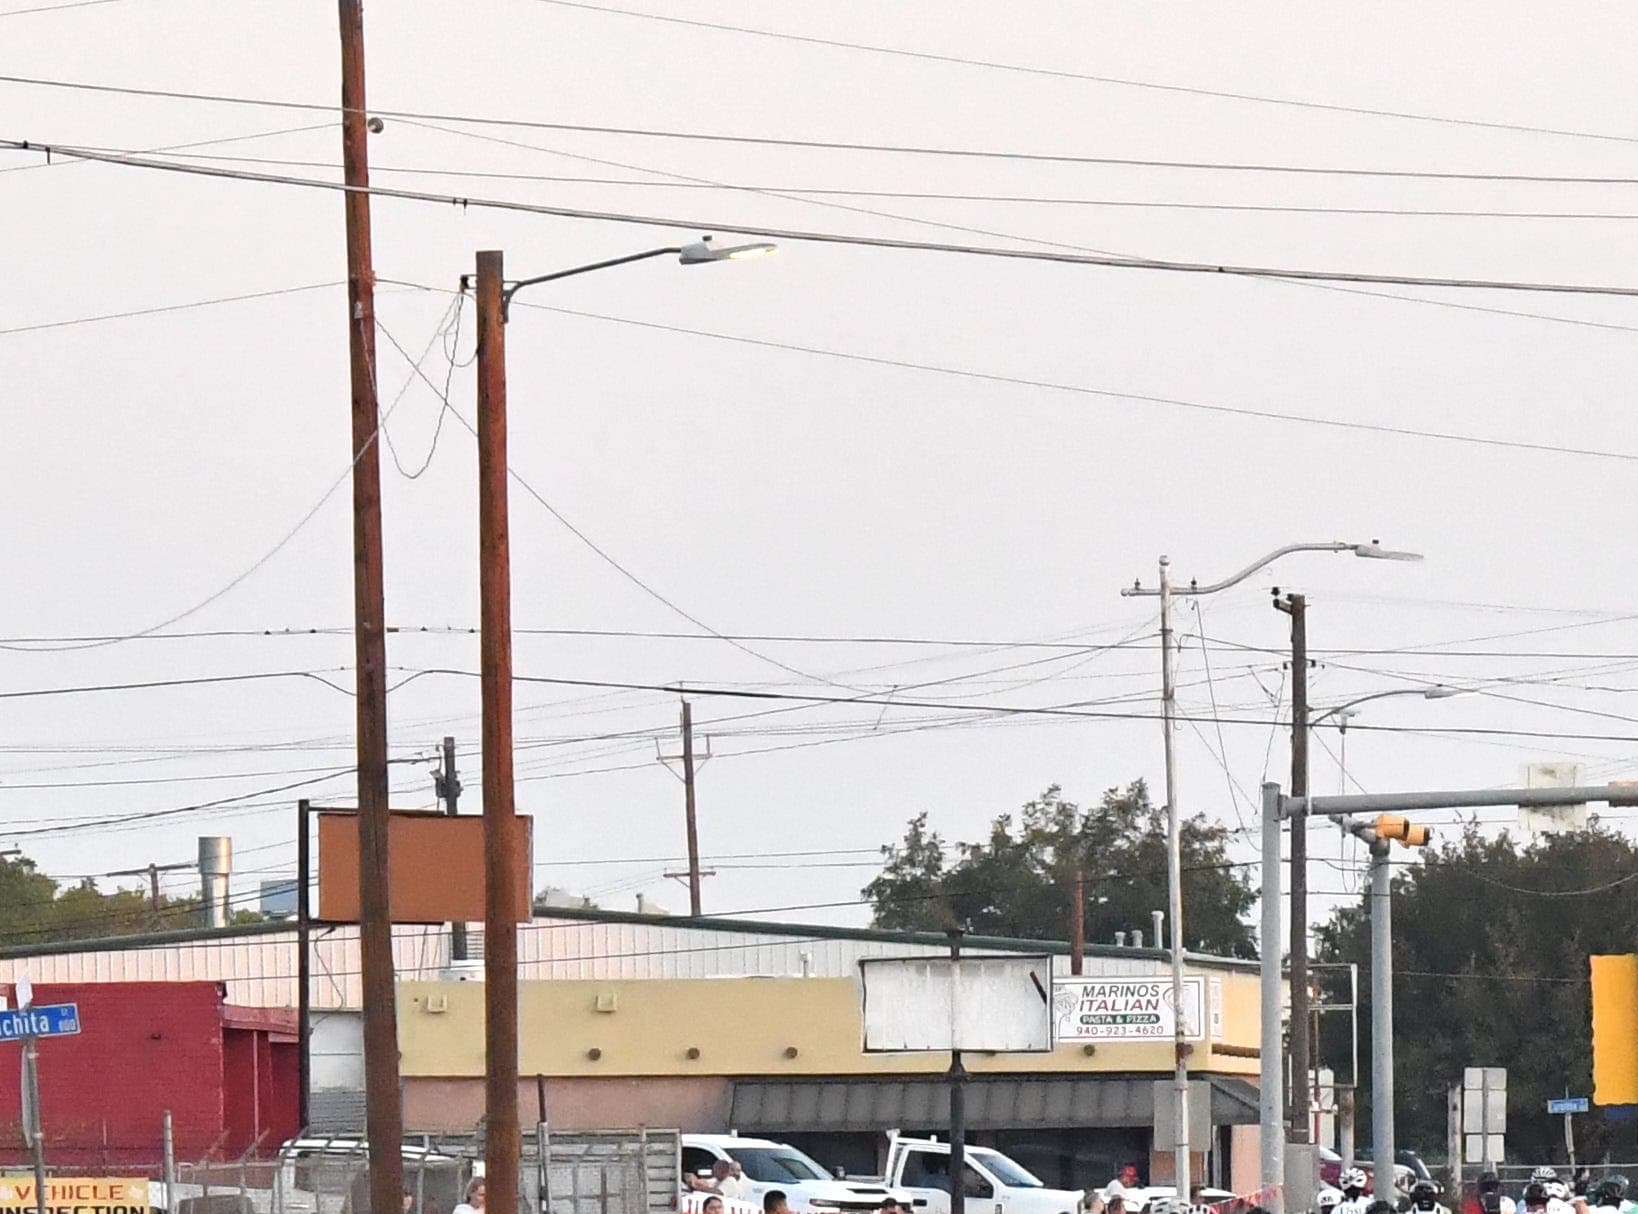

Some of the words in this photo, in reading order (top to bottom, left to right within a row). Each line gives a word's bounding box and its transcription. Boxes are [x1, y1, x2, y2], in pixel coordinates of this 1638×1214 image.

[1081, 984, 1160, 998] MARINOS
[1079, 999, 1160, 1012] ITALIAN
[1082, 1014, 1113, 1024] PASTA
[1115, 1014, 1124, 1024] &
[1126, 1014, 1157, 1024] PIZZA
[1076, 1026, 1164, 1036] 940-923-4620
